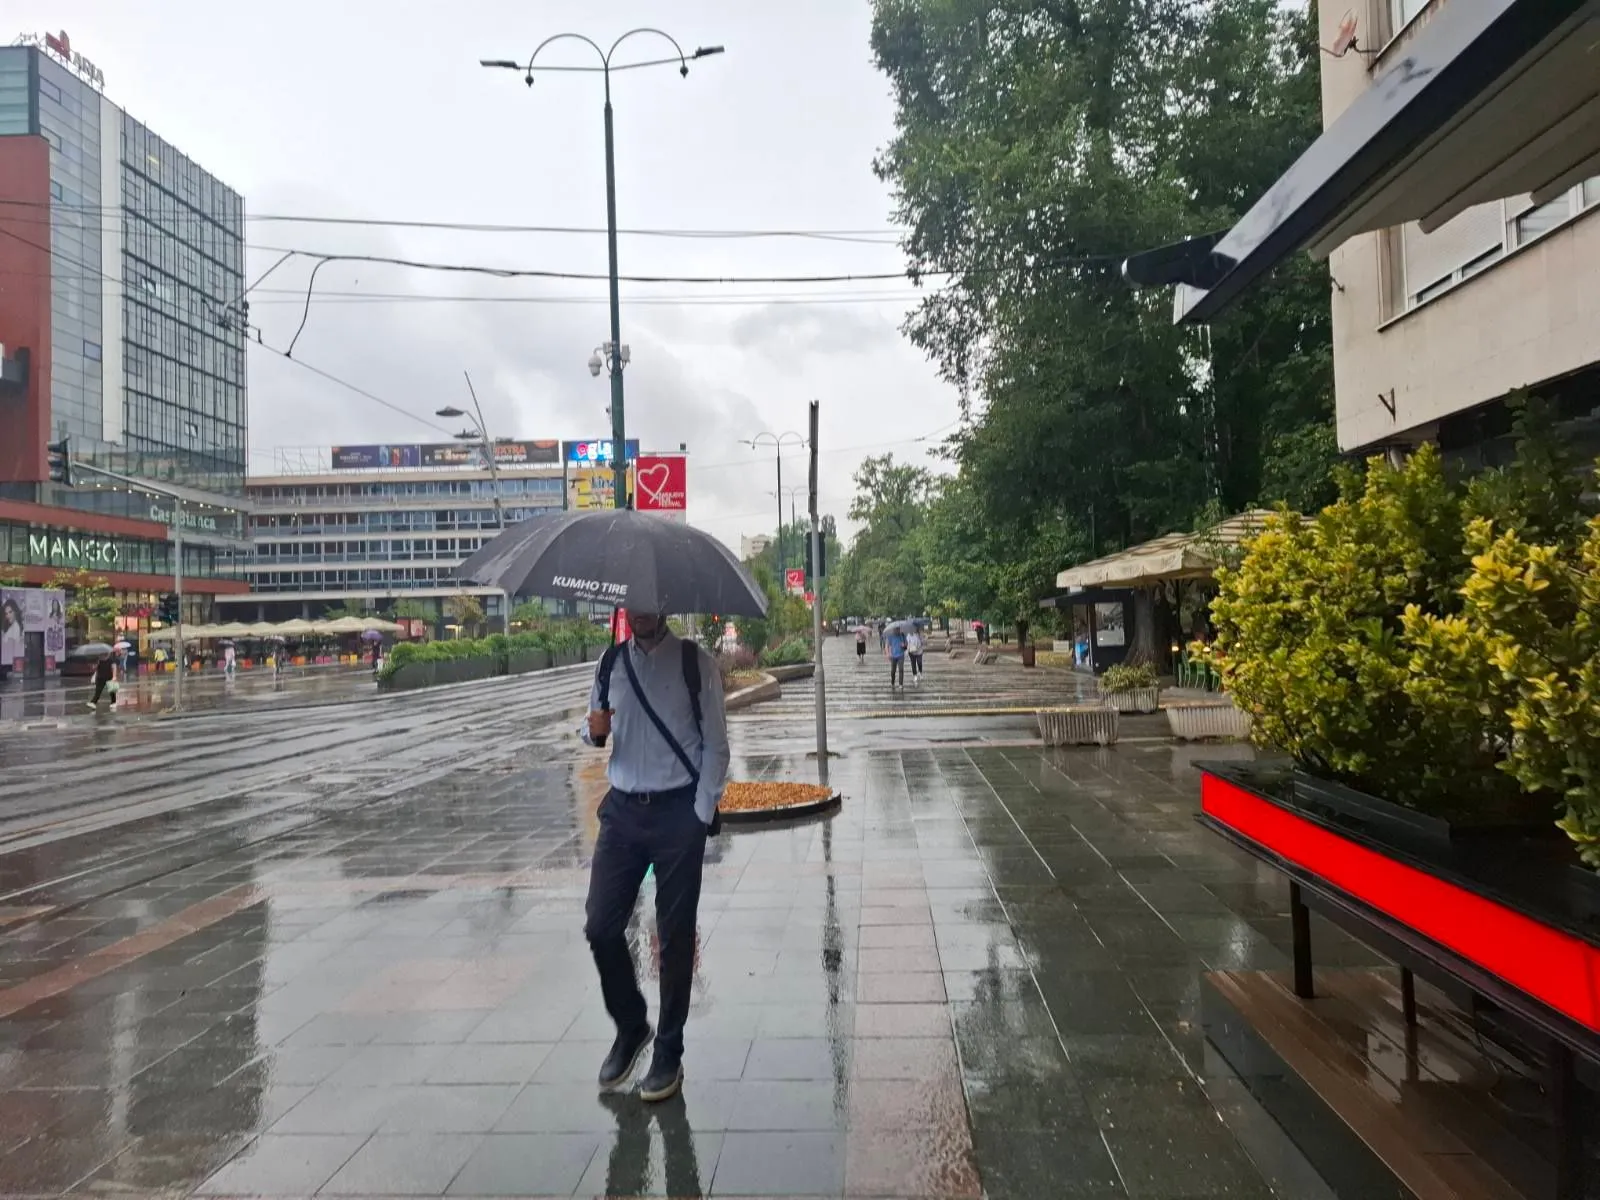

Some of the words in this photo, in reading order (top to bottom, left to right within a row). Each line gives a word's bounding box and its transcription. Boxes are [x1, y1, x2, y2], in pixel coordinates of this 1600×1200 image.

[29, 534, 118, 563] MANGO
[552, 575, 600, 591] KUMHO
[601, 582, 628, 595] TIRE
